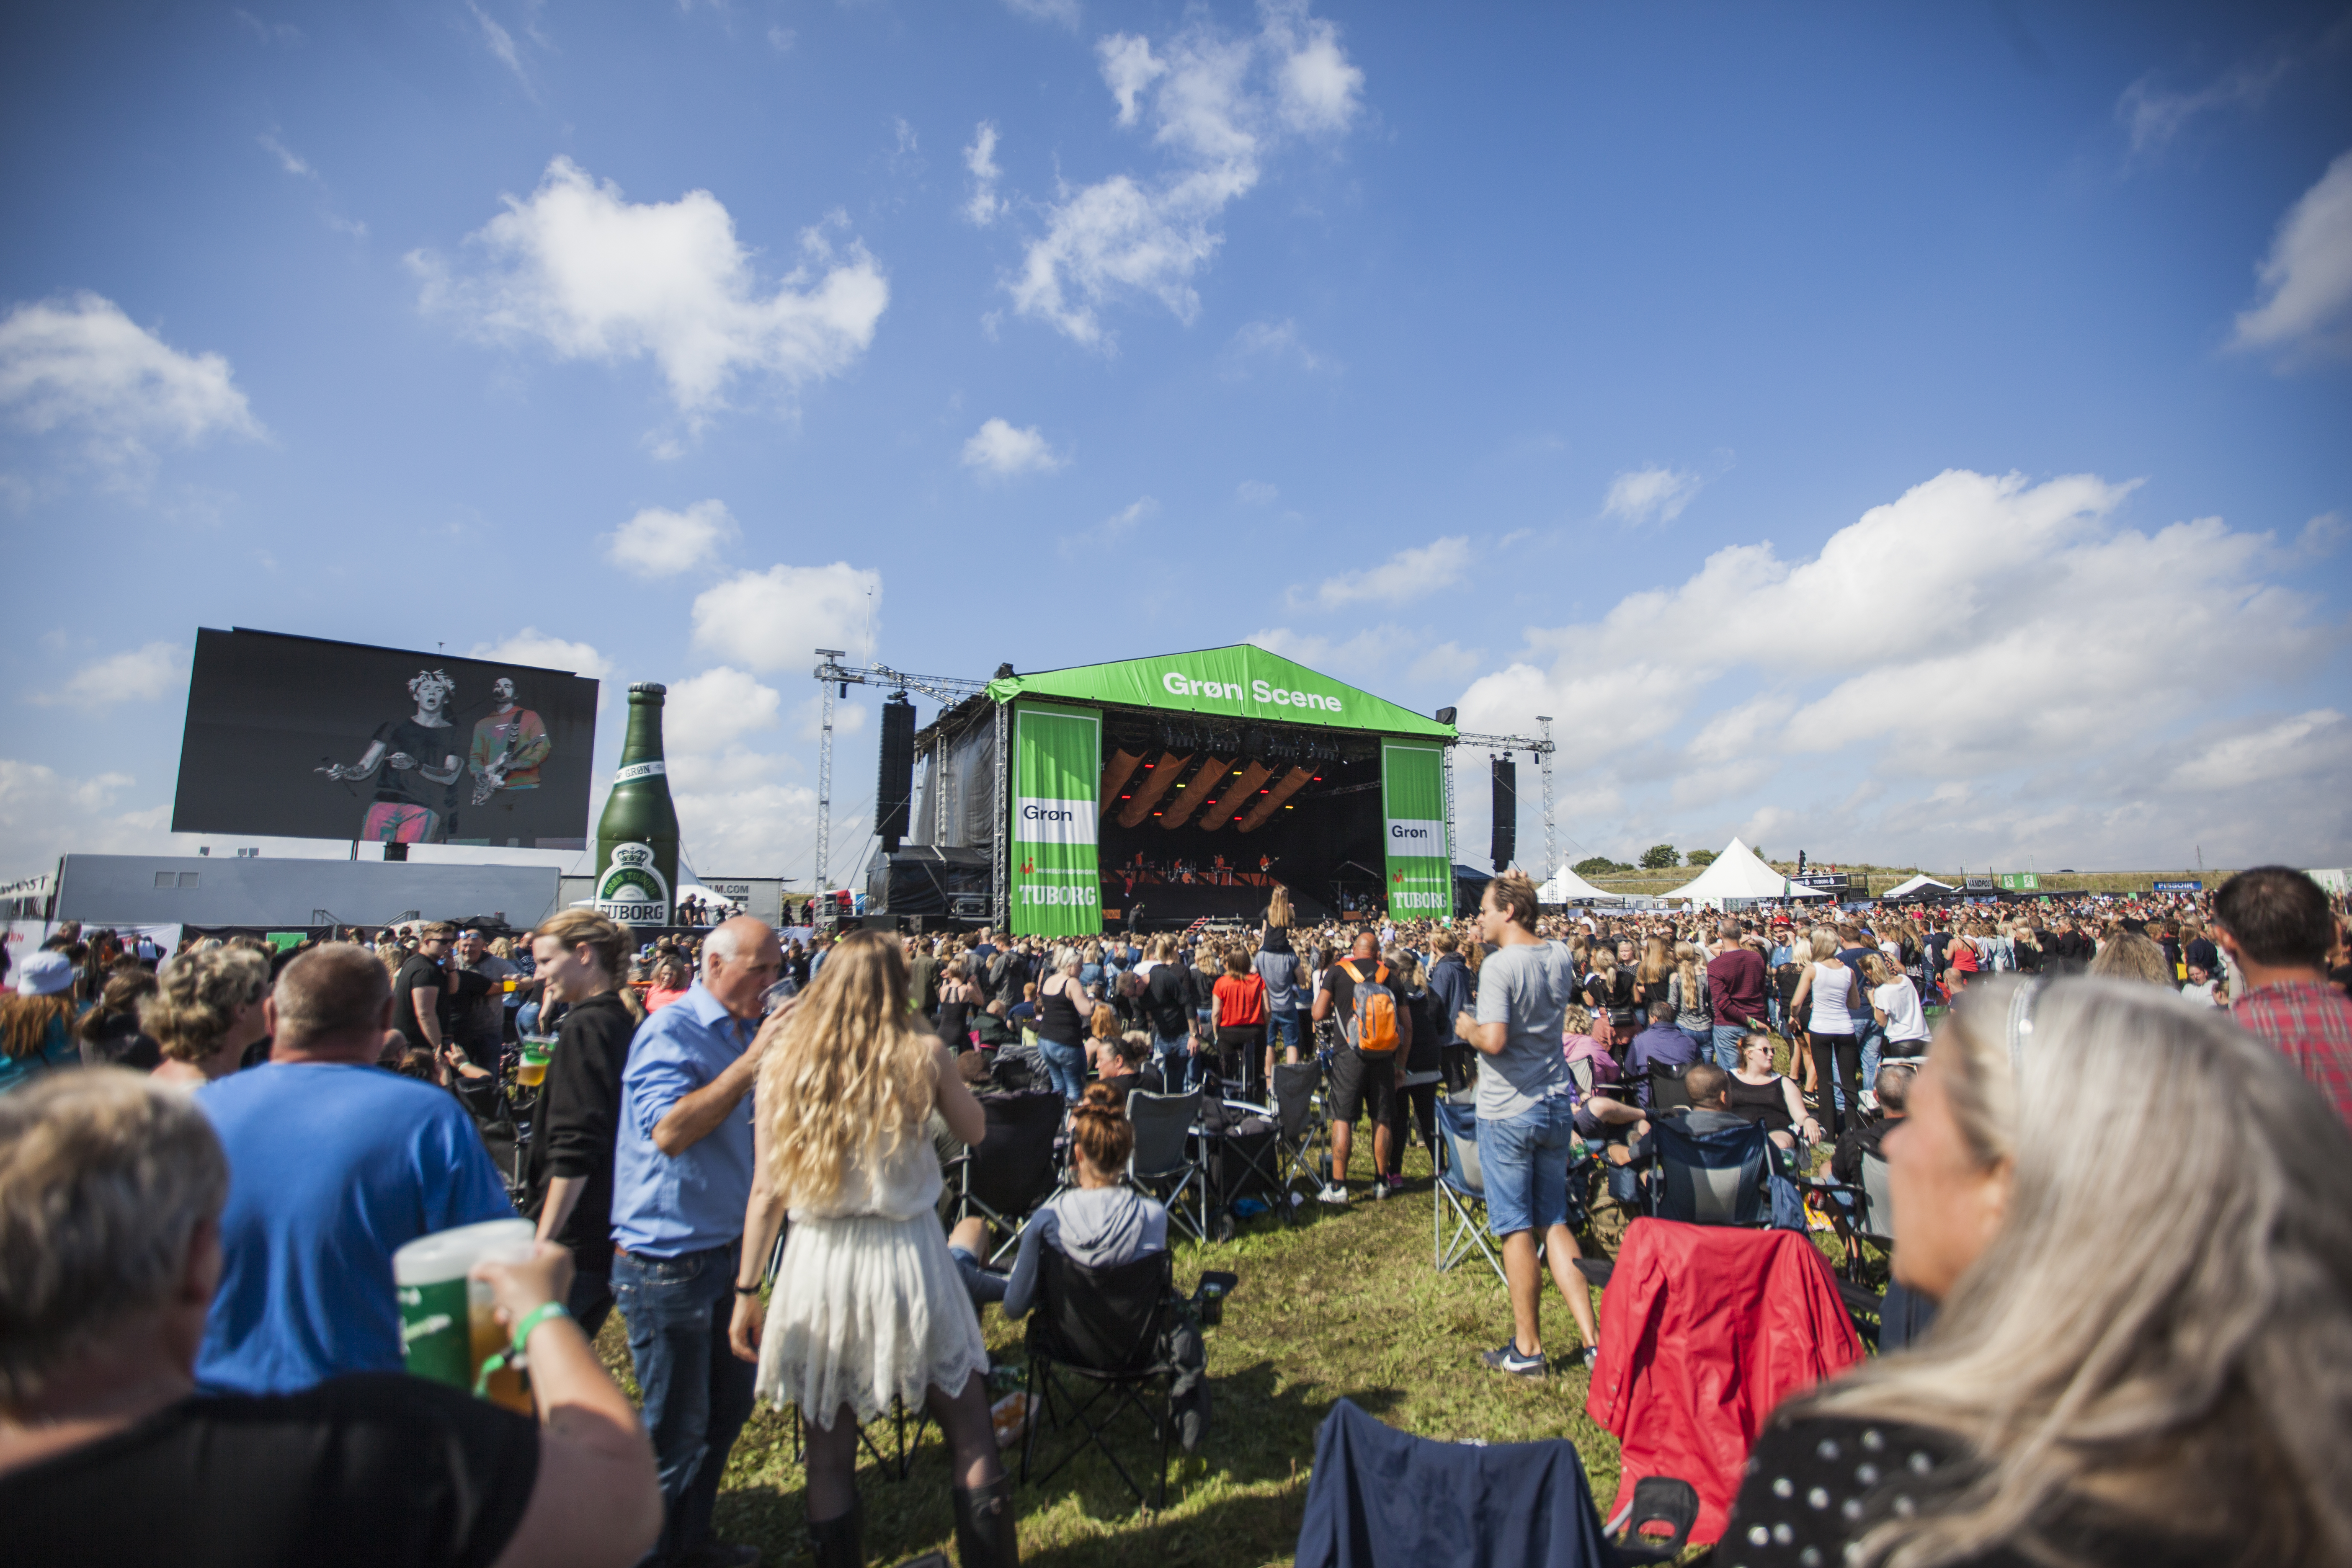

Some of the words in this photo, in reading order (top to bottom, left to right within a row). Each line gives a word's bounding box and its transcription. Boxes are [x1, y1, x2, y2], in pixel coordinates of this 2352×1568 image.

[1163, 672, 1243, 700] Grøn
[1252, 680, 1342, 712] Scene
[625, 765, 650, 777] GRØN
[1024, 805, 1072, 821] Grøn
[1392, 825, 1428, 838] Grøn
[605, 874, 624, 895] GRØN
[626, 872, 658, 895] TUBORG
[705, 885, 748, 894] M.COM
[1019, 885, 1096, 905] TUBORG
[1393, 892, 1447, 908] TUBORG
